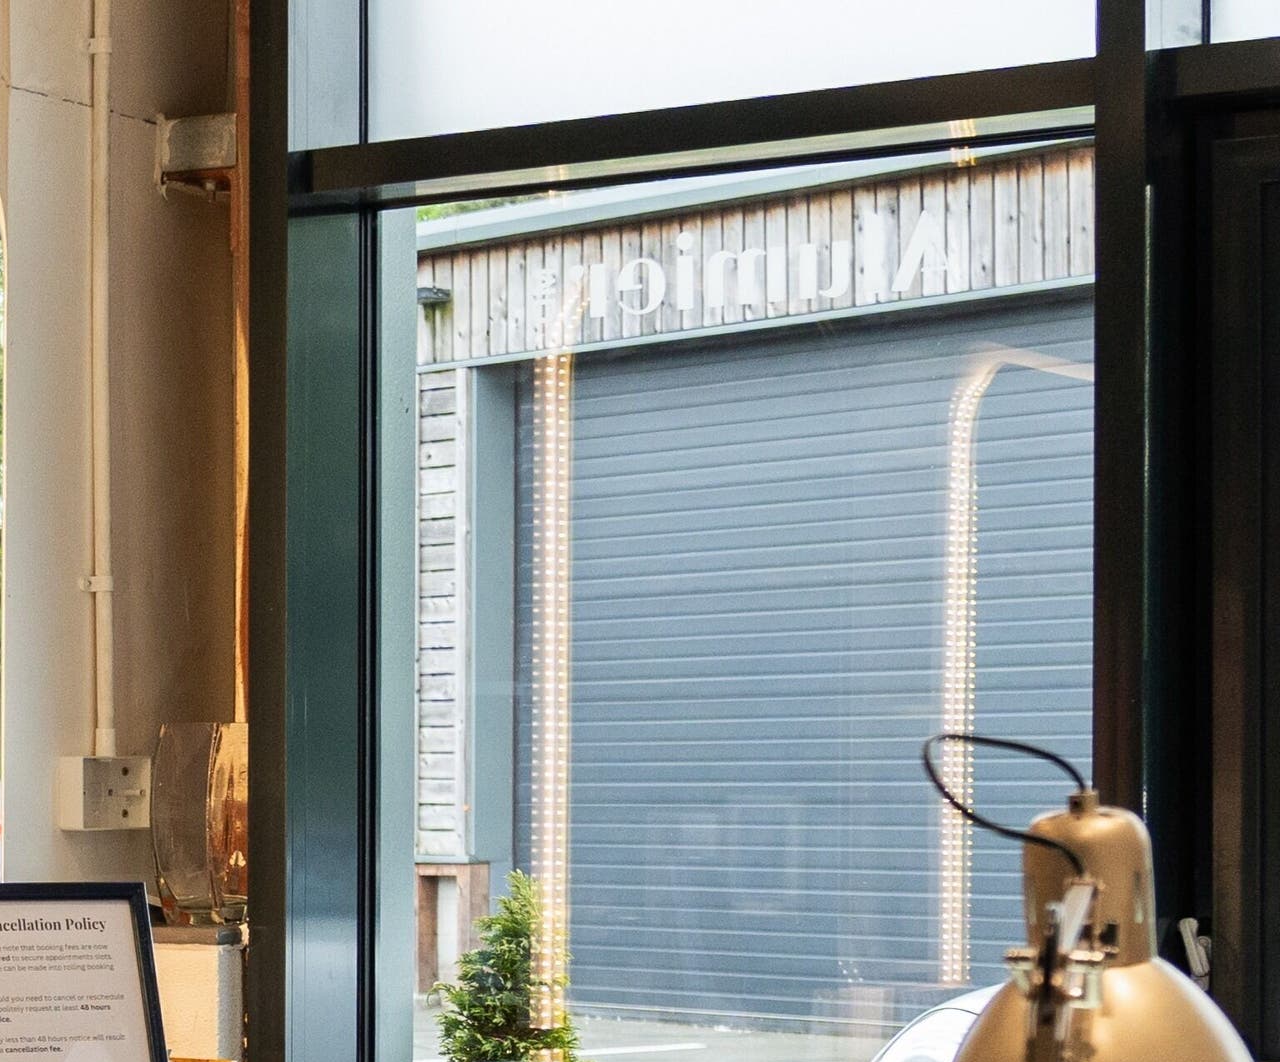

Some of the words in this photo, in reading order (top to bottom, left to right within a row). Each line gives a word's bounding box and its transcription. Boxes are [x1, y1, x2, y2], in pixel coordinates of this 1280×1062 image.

[65, 917, 107, 932] Policy
[90, 1003, 111, 1011] hours
[19, 1035, 37, 1043] than
[47, 1034, 67, 1042] hours
